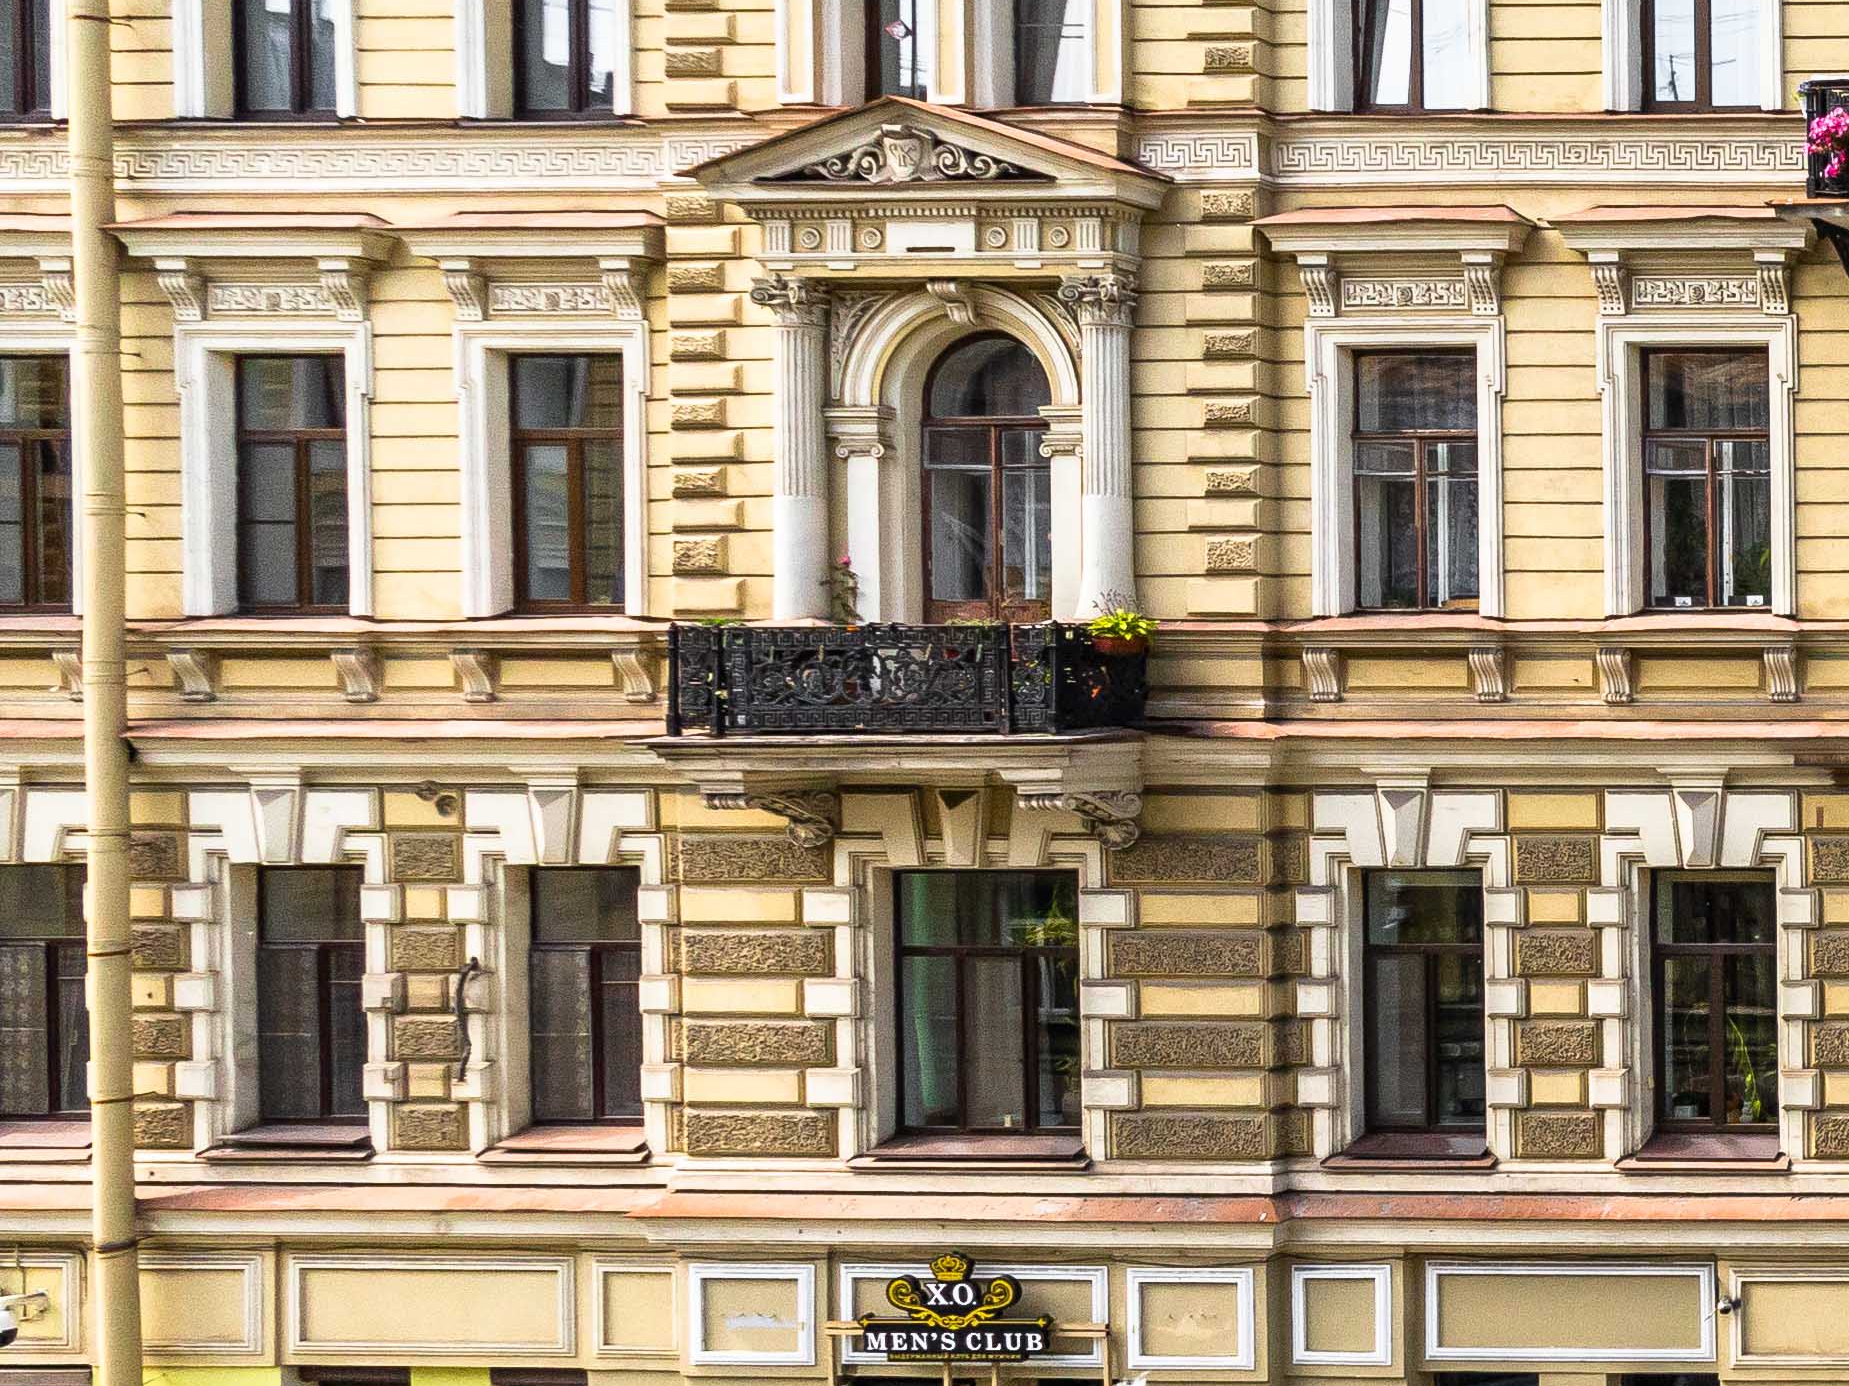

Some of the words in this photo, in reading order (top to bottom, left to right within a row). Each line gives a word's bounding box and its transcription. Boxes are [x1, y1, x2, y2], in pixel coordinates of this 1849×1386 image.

[926, 1283, 977, 1306] X.O.
[865, 1332, 956, 1351] MEN'S
[965, 1332, 1043, 1351] CLUB
